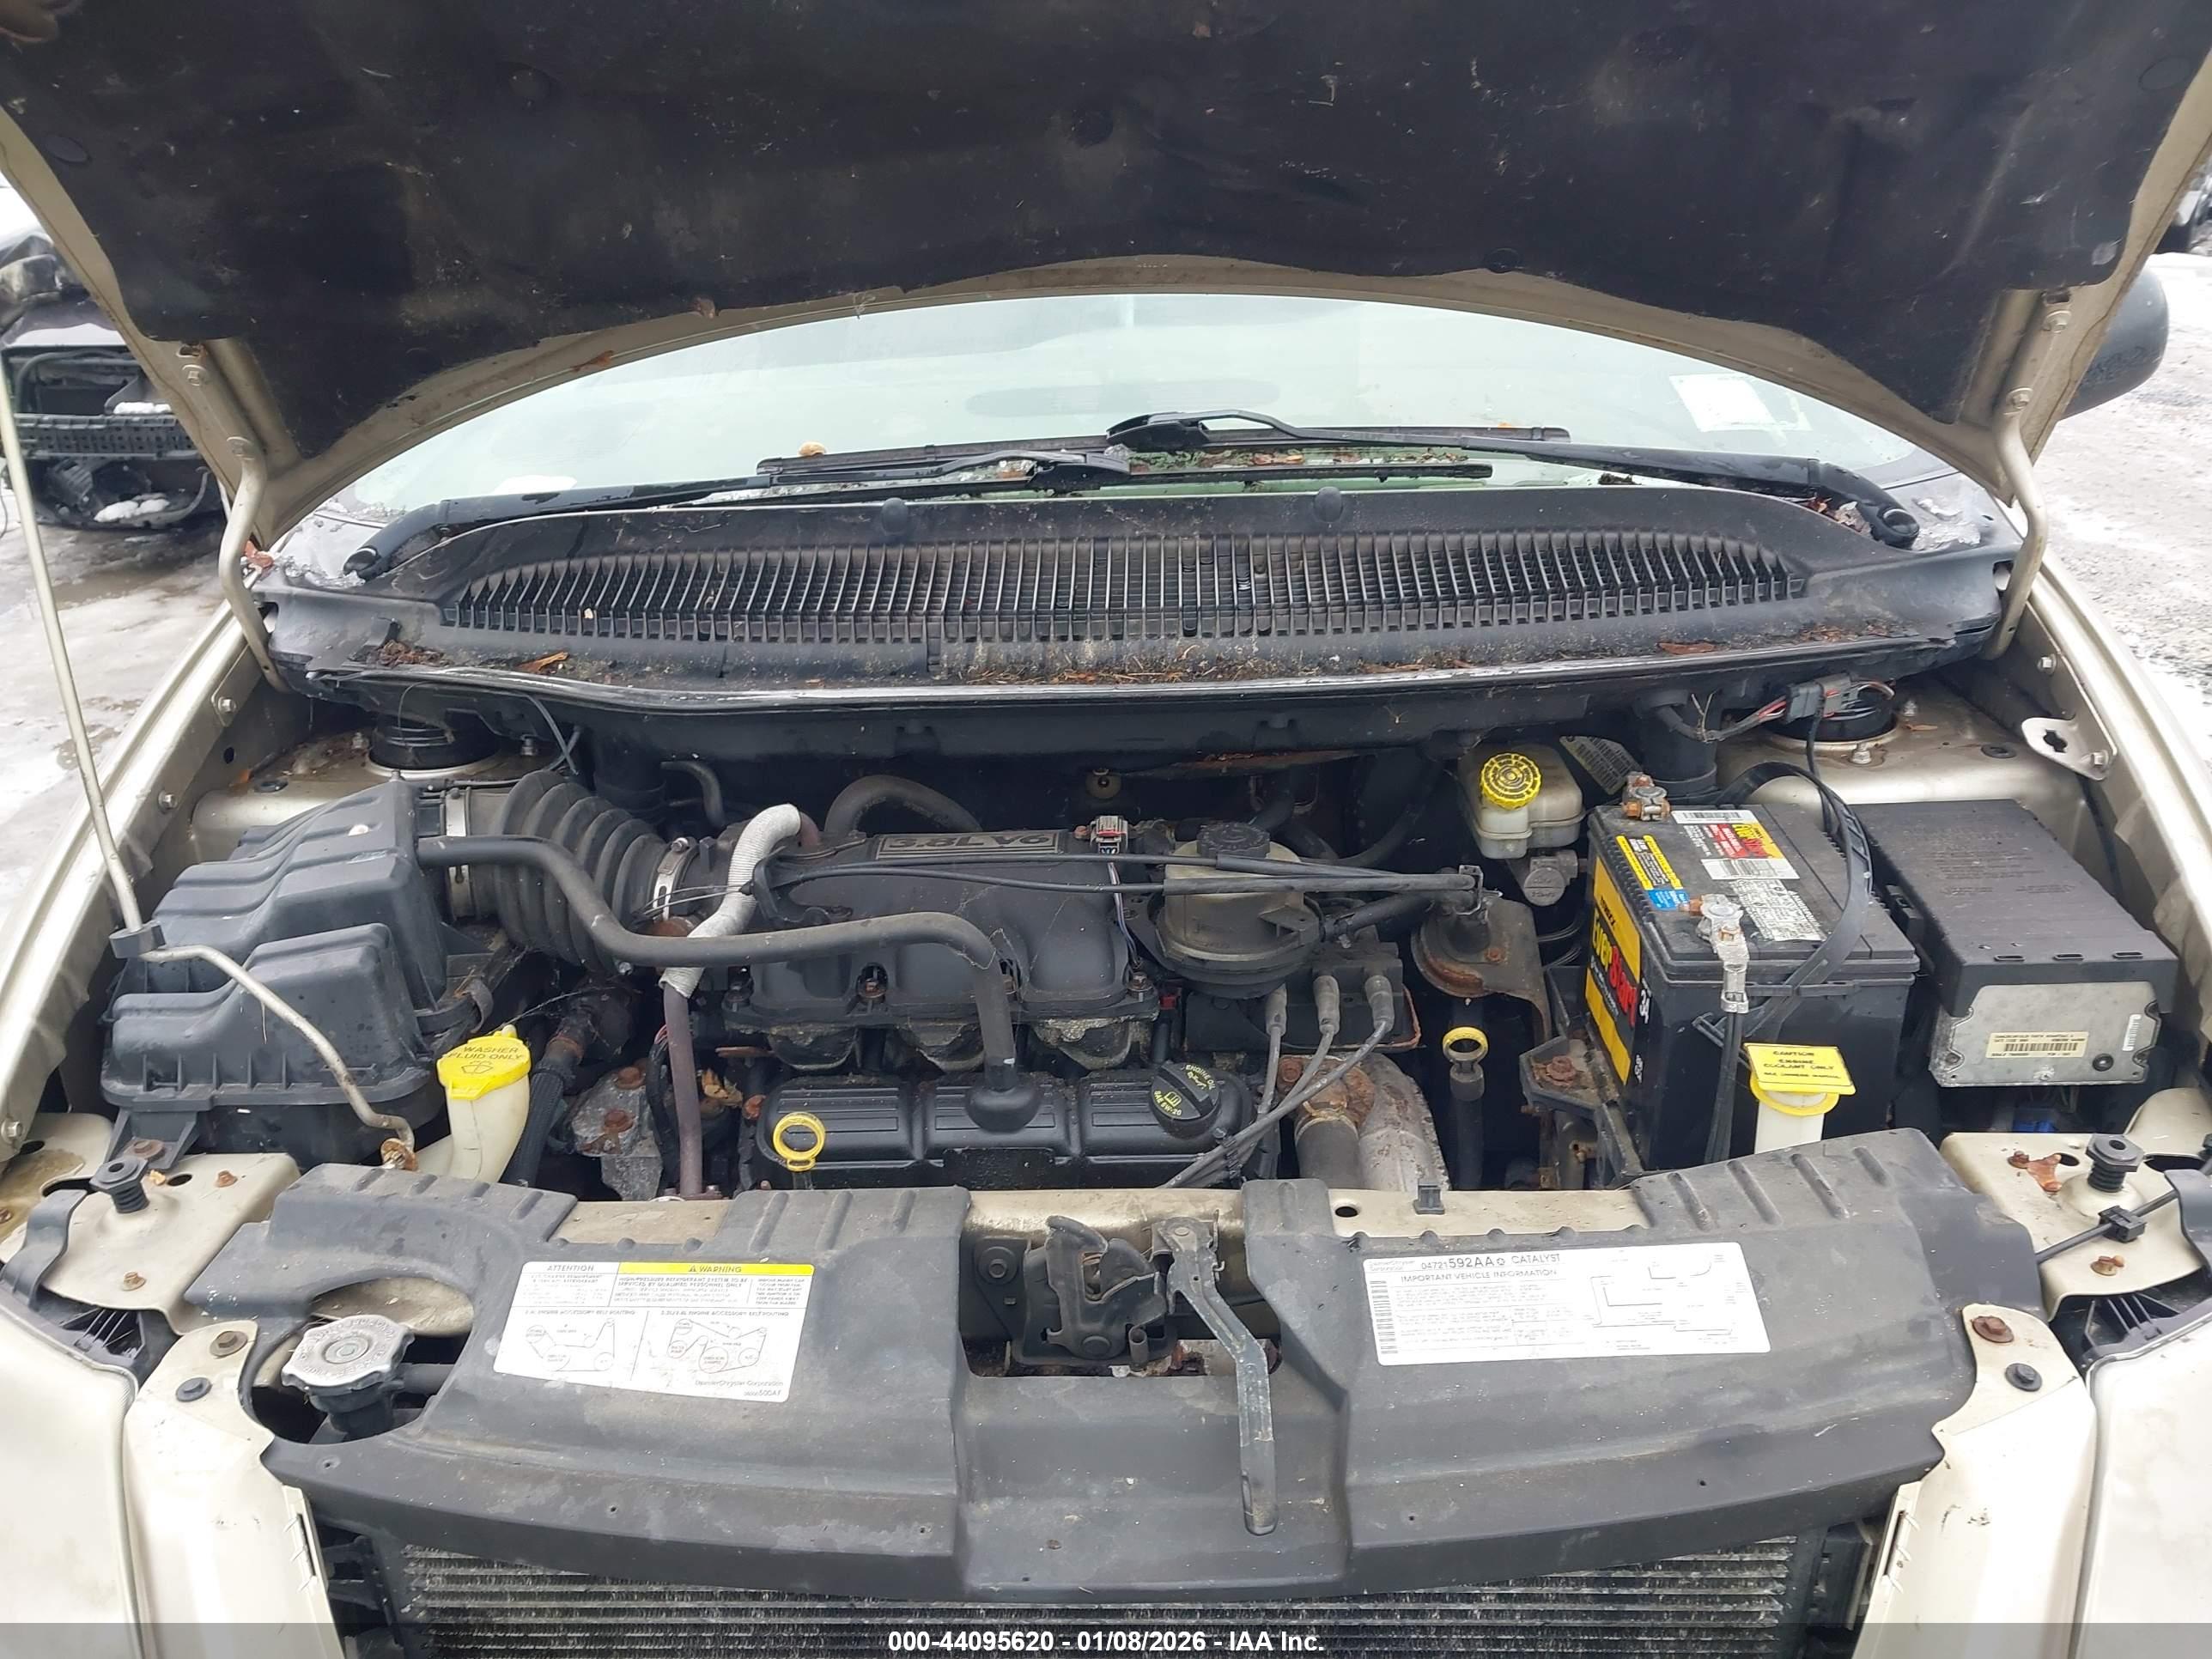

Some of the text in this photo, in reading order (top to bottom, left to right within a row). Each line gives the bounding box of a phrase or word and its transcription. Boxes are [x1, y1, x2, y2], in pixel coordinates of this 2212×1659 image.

[888, 834, 1049, 848] 3.8L V6
[1185, 1064, 1217, 1091] ENGINE OIL
[1153, 1091, 1182, 1115] SAE 5W-20
[1511, 1254, 1561, 1265] CATALYST
[1401, 1269, 1557, 1283] IMPORTANT VEHICLE INFORMATION
